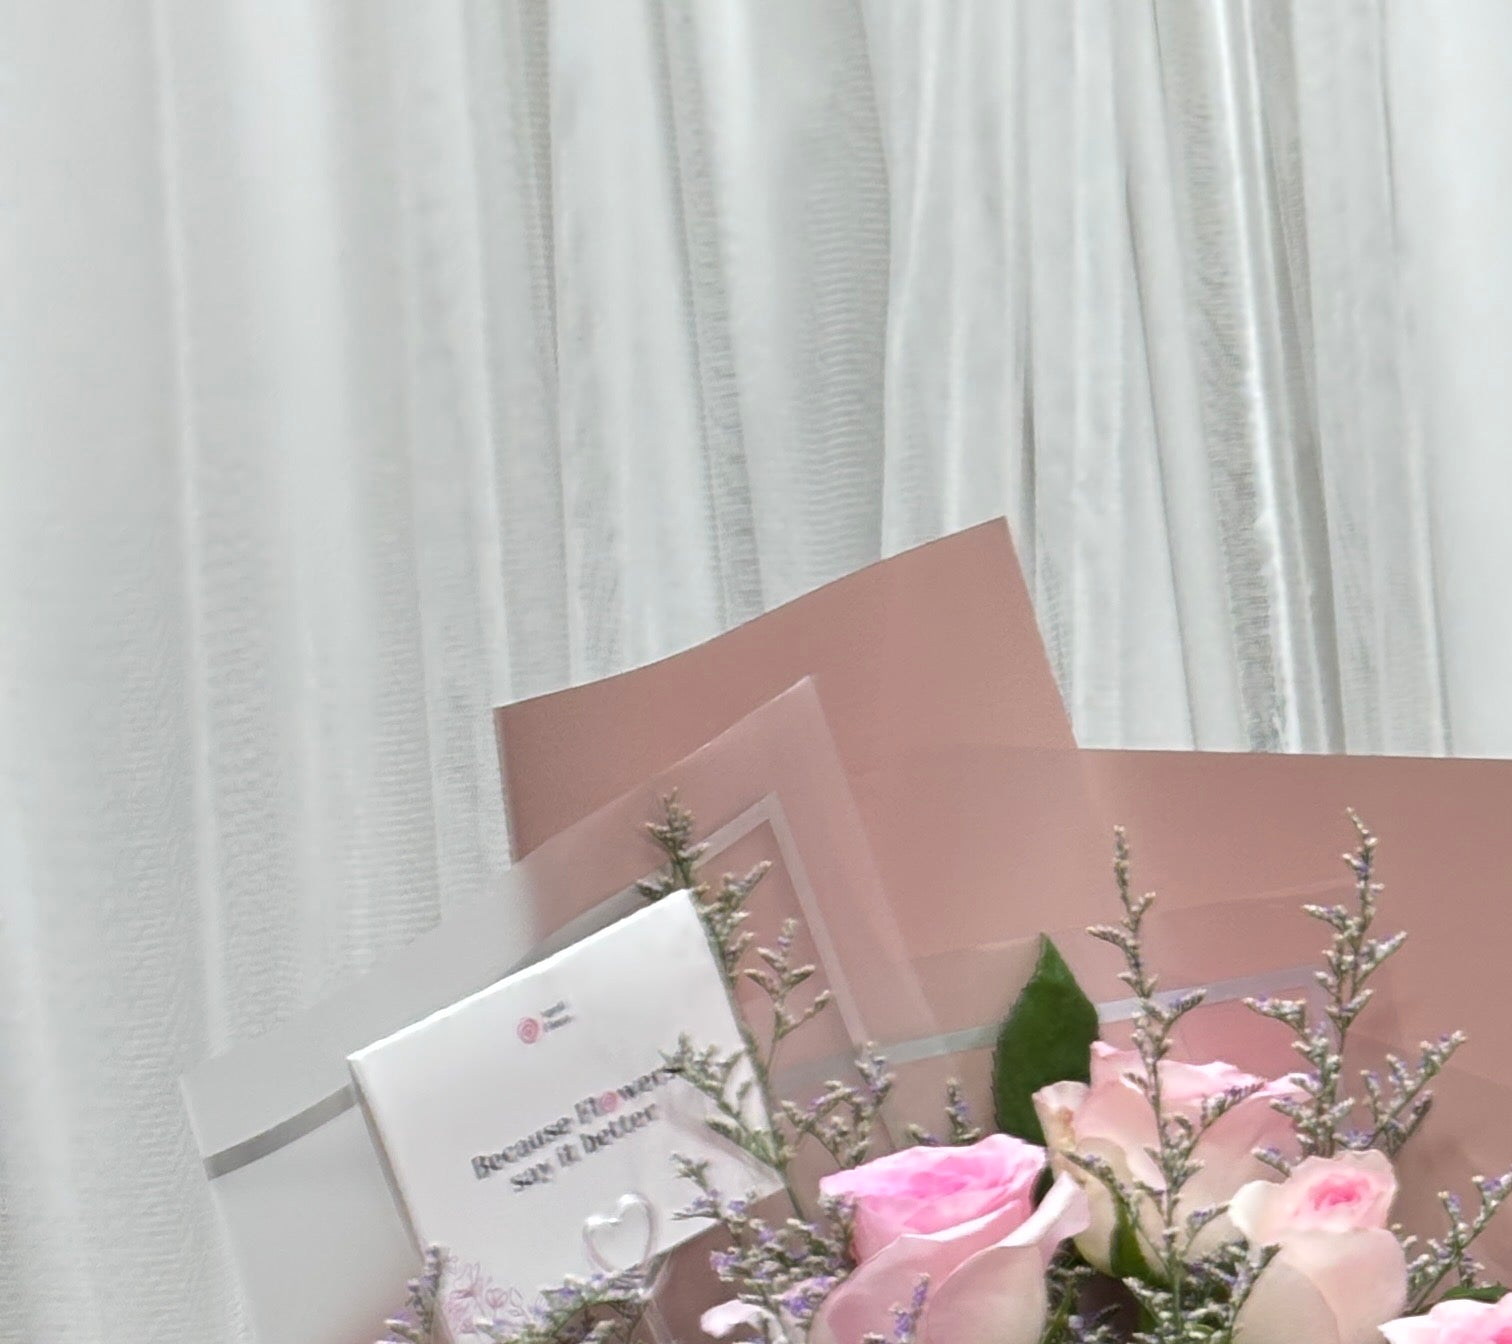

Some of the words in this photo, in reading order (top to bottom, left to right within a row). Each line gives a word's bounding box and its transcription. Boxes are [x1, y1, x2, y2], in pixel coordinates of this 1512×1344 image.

[471, 1116, 572, 1180] Because
[510, 1162, 553, 1192] say
[556, 1143, 582, 1168] it
[579, 1103, 659, 1153] better
